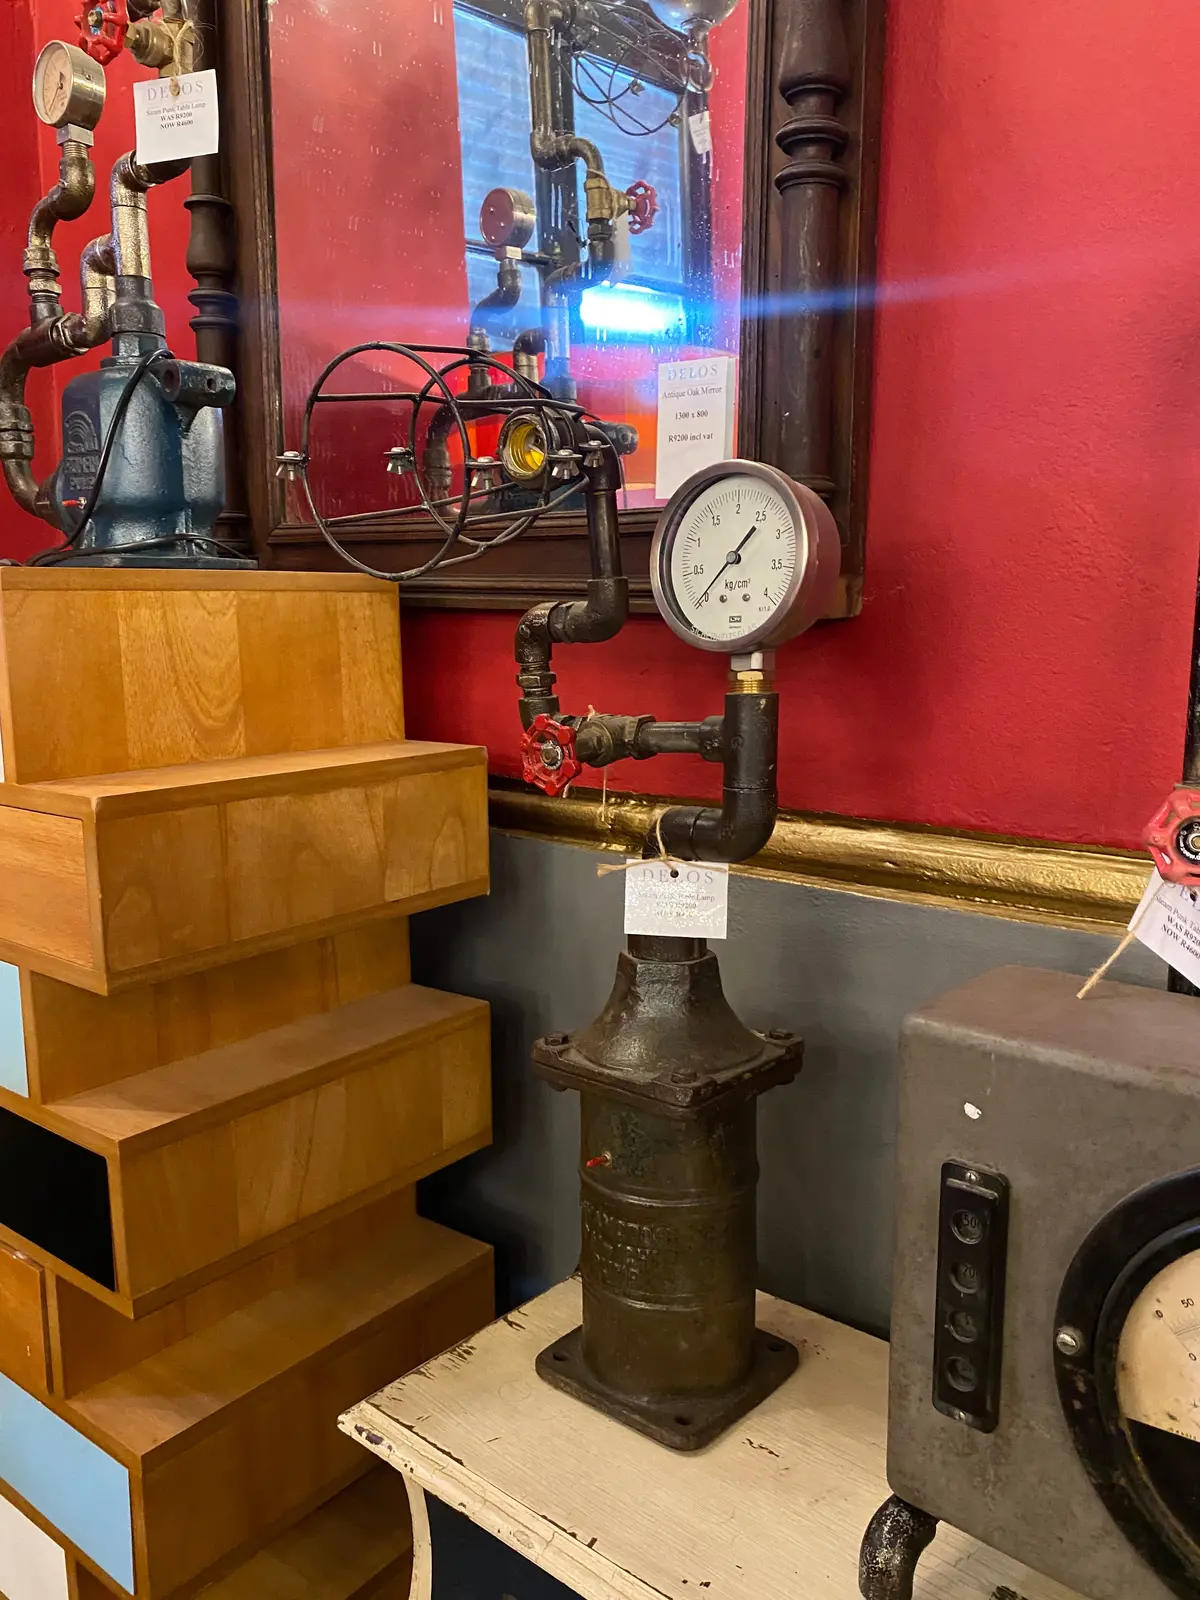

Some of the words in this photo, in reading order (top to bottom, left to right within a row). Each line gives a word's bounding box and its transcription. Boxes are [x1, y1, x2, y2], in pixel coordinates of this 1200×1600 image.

[147, 80, 204, 101] DEOS
[175, 111, 193, 120] R9200
[160, 122, 175, 130] NOW
[176, 119, 194, 127] R4600
[668, 364, 718, 381] DELOS
[662, 389, 685, 400] Antique
[686, 387, 700, 397] Oak
[701, 387, 721, 395] Mirror
[675, 410, 690, 420] 1300
[696, 409, 709, 419] 800
[668, 433, 689, 443] R9200
[689, 432, 702, 441] incl
[703, 433, 714, 441] vat
[736, 504, 740, 514] 2
[711, 515, 721, 526] 1,5
[755, 511, 767, 522] 2,5
[776, 529, 781, 539] 3
[697, 538, 702, 547] 1
[693, 564, 704, 576] 0,5
[771, 558, 783, 571] 3,5
[705, 593, 709, 602] 0
[763, 588, 768, 597] 4
[642, 867, 714, 886] DEOS
[696, 894, 715, 903] Lamp
[1154, 893, 1173, 912] Steam
[1173, 907, 1189, 925] Punk
[1166, 914, 1185, 933] WAS
[1161, 923, 1182, 942] NOW
[1181, 1298, 1194, 1308] 50
[1155, 1310, 1163, 1318] 0
[1189, 1353, 1196, 1361] 0
